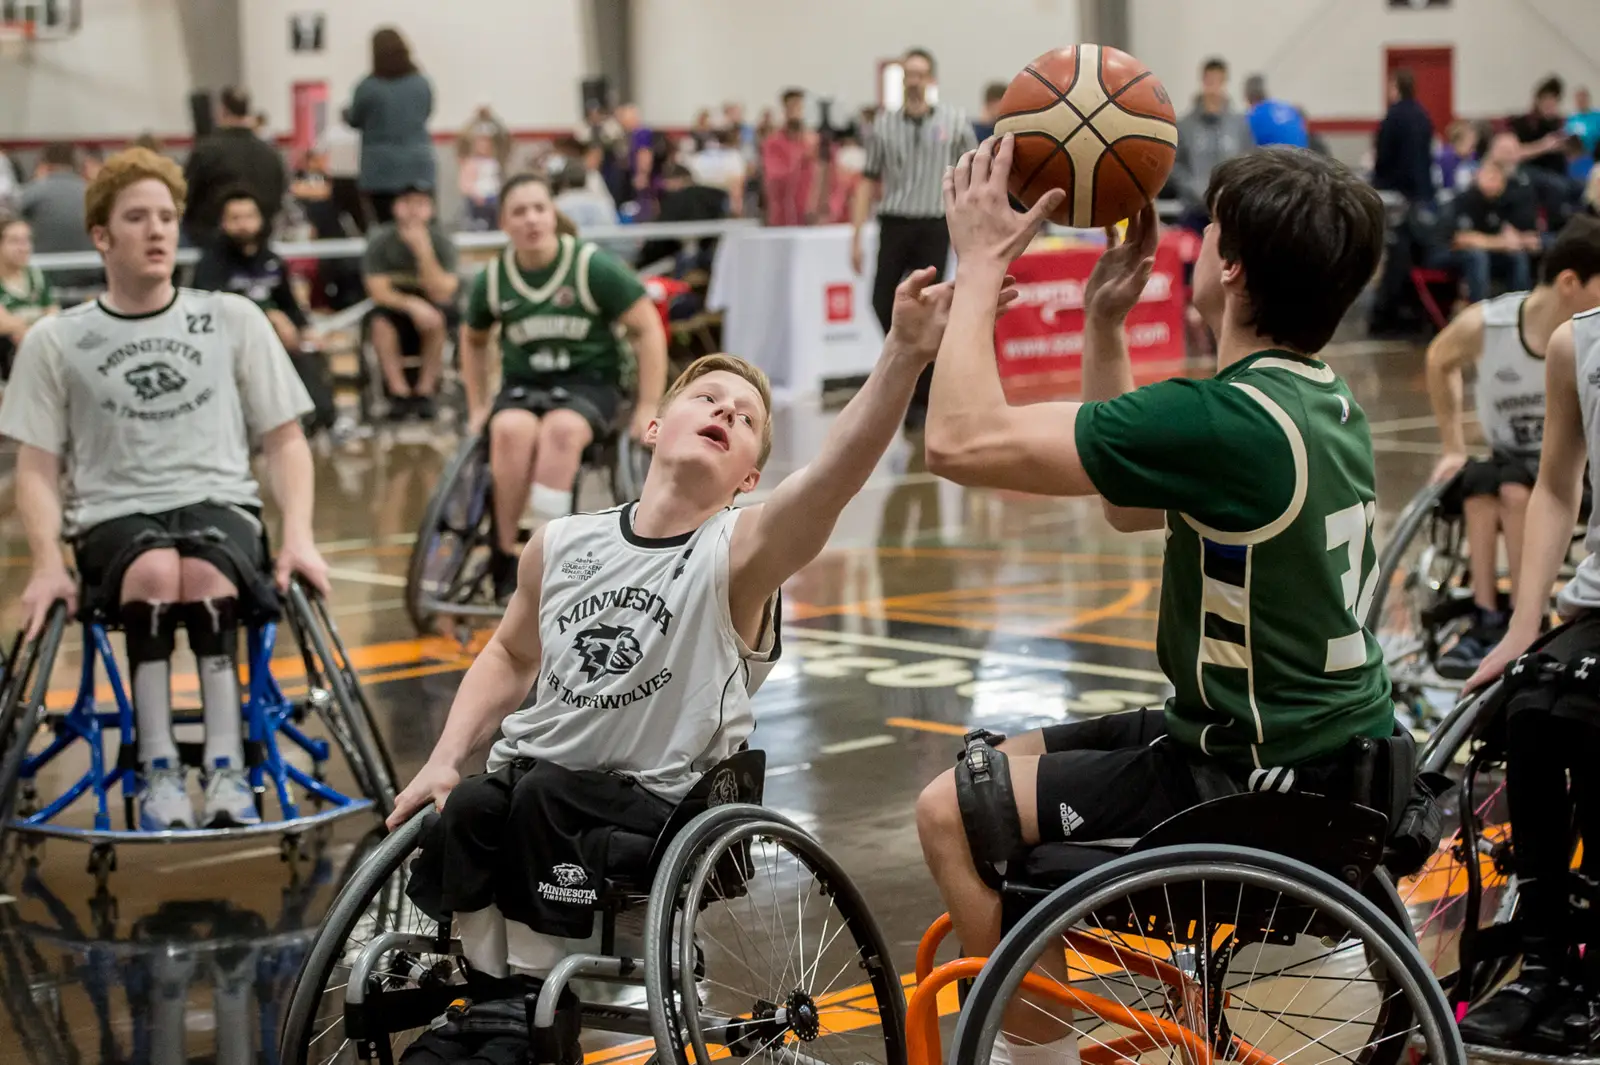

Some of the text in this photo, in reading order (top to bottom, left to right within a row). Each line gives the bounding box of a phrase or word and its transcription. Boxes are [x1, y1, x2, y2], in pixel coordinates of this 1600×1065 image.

[187, 313, 215, 334] 22
[1060, 802, 1071, 837] adidas
[537, 881, 598, 901] MINNESOTA
[543, 892, 592, 905] TIMBERWOLVES
